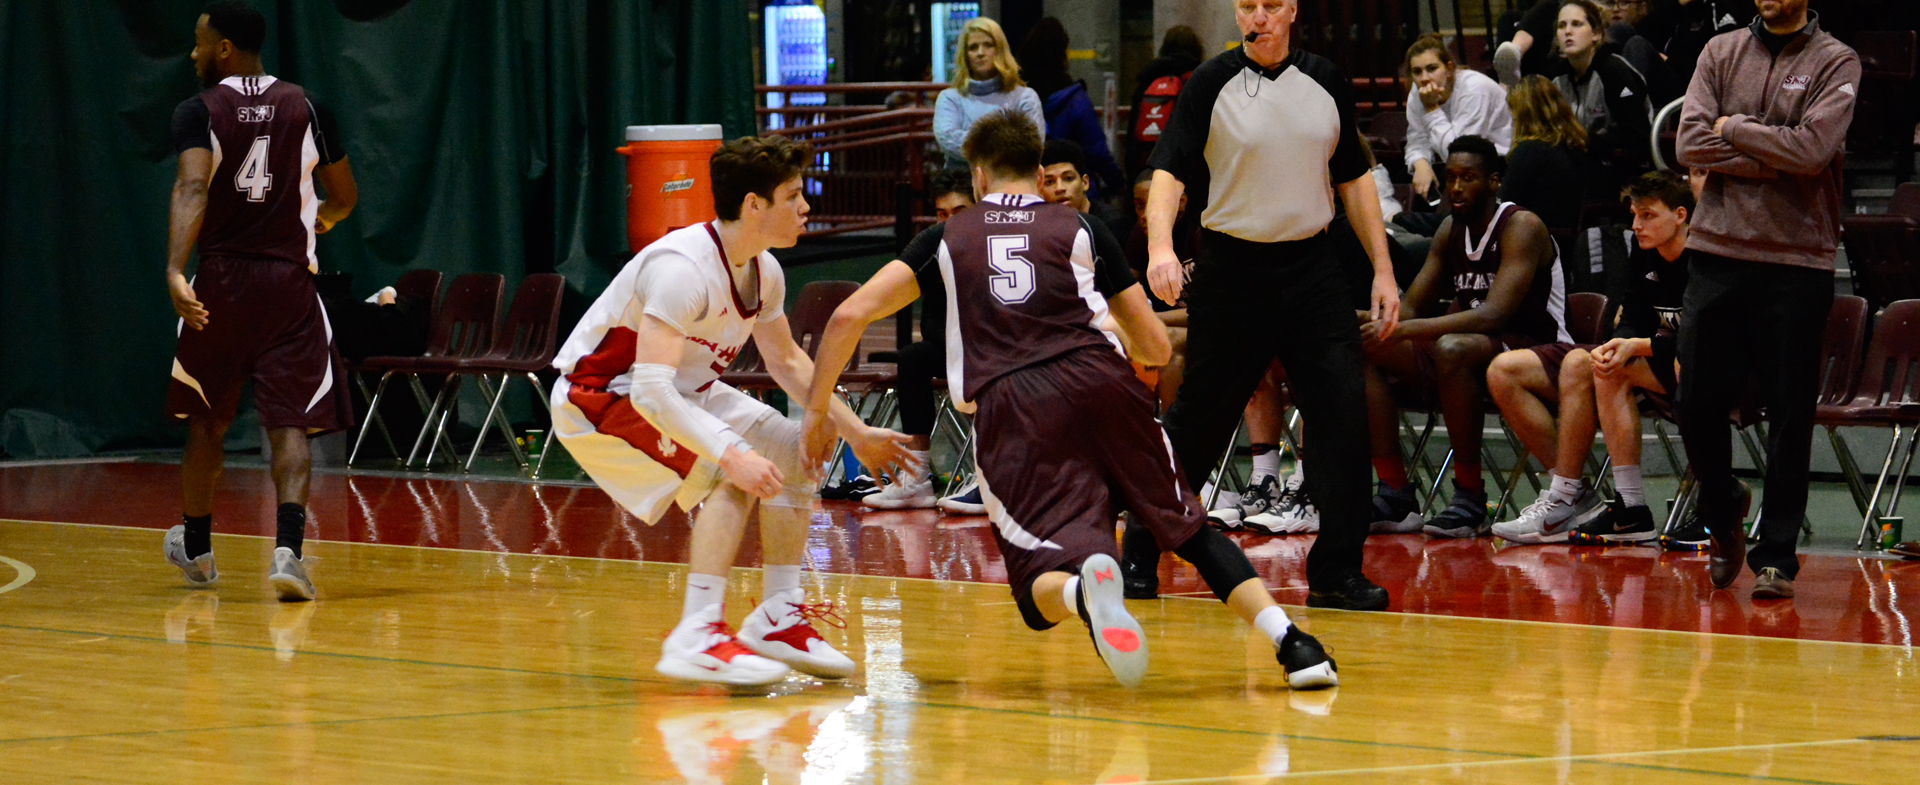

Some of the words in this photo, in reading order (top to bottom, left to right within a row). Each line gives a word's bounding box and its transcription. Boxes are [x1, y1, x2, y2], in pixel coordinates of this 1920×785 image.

[238, 105, 274, 122] SMU
[234, 135, 273, 202] 4
[985, 210, 1035, 224] SMU
[987, 234, 1036, 305] 5
